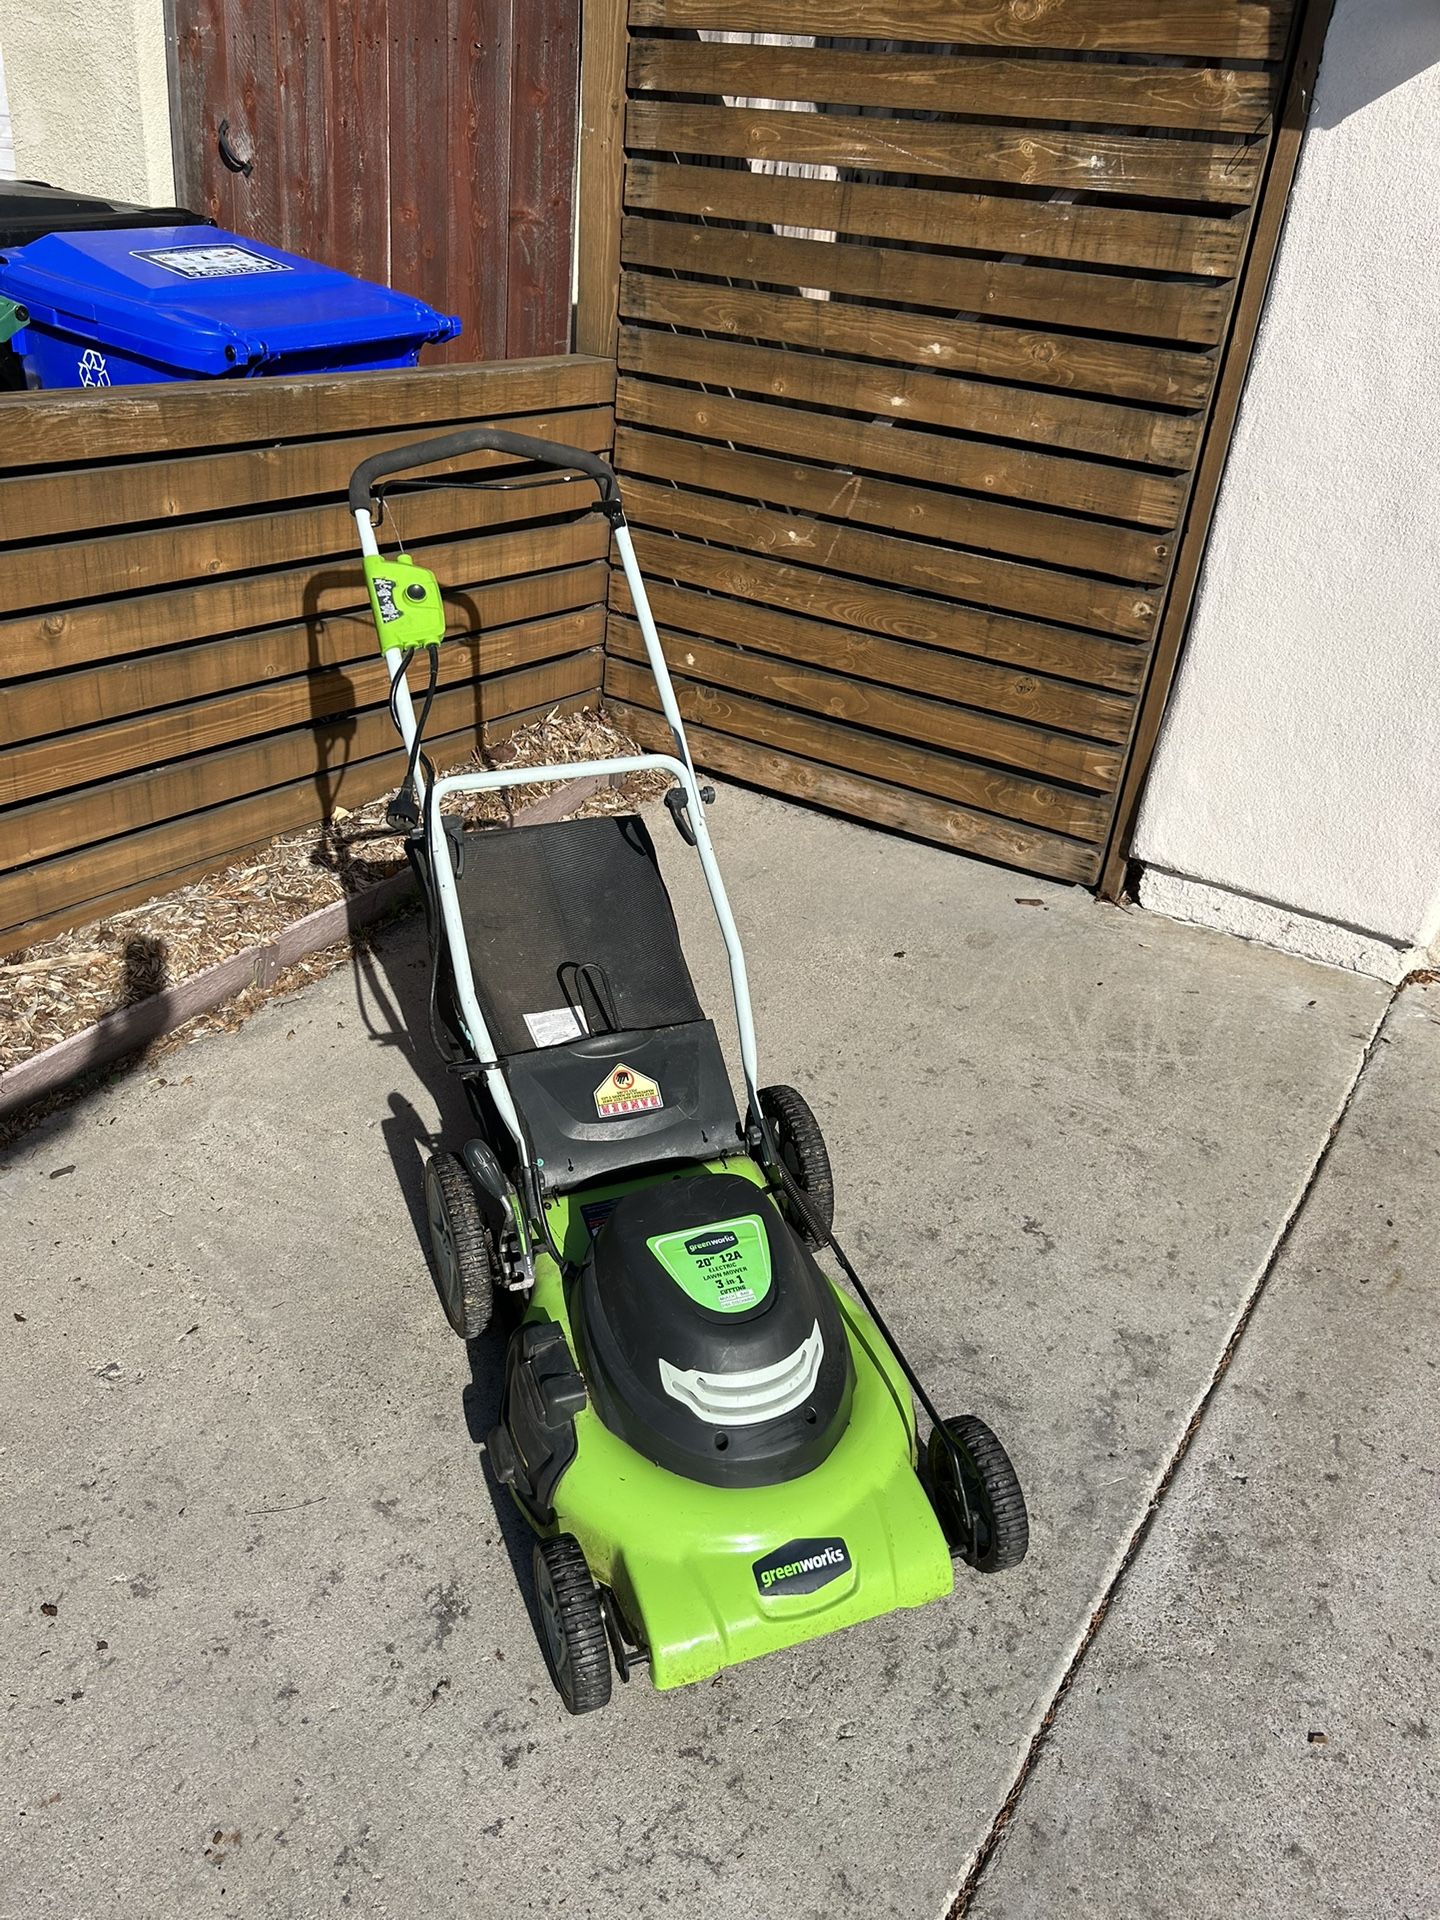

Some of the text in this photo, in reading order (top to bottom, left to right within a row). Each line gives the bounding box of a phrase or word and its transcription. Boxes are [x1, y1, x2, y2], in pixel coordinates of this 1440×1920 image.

[689, 1235, 735, 1252] greenworks
[719, 1251, 743, 1263] 12A
[703, 1266, 748, 1281] LAWN MOWER
[709, 1262, 737, 1273] ELECTRIC
[715, 1279, 724, 1289] 3
[737, 1275, 744, 1284] 1
[761, 1547, 844, 1588] greenworks
